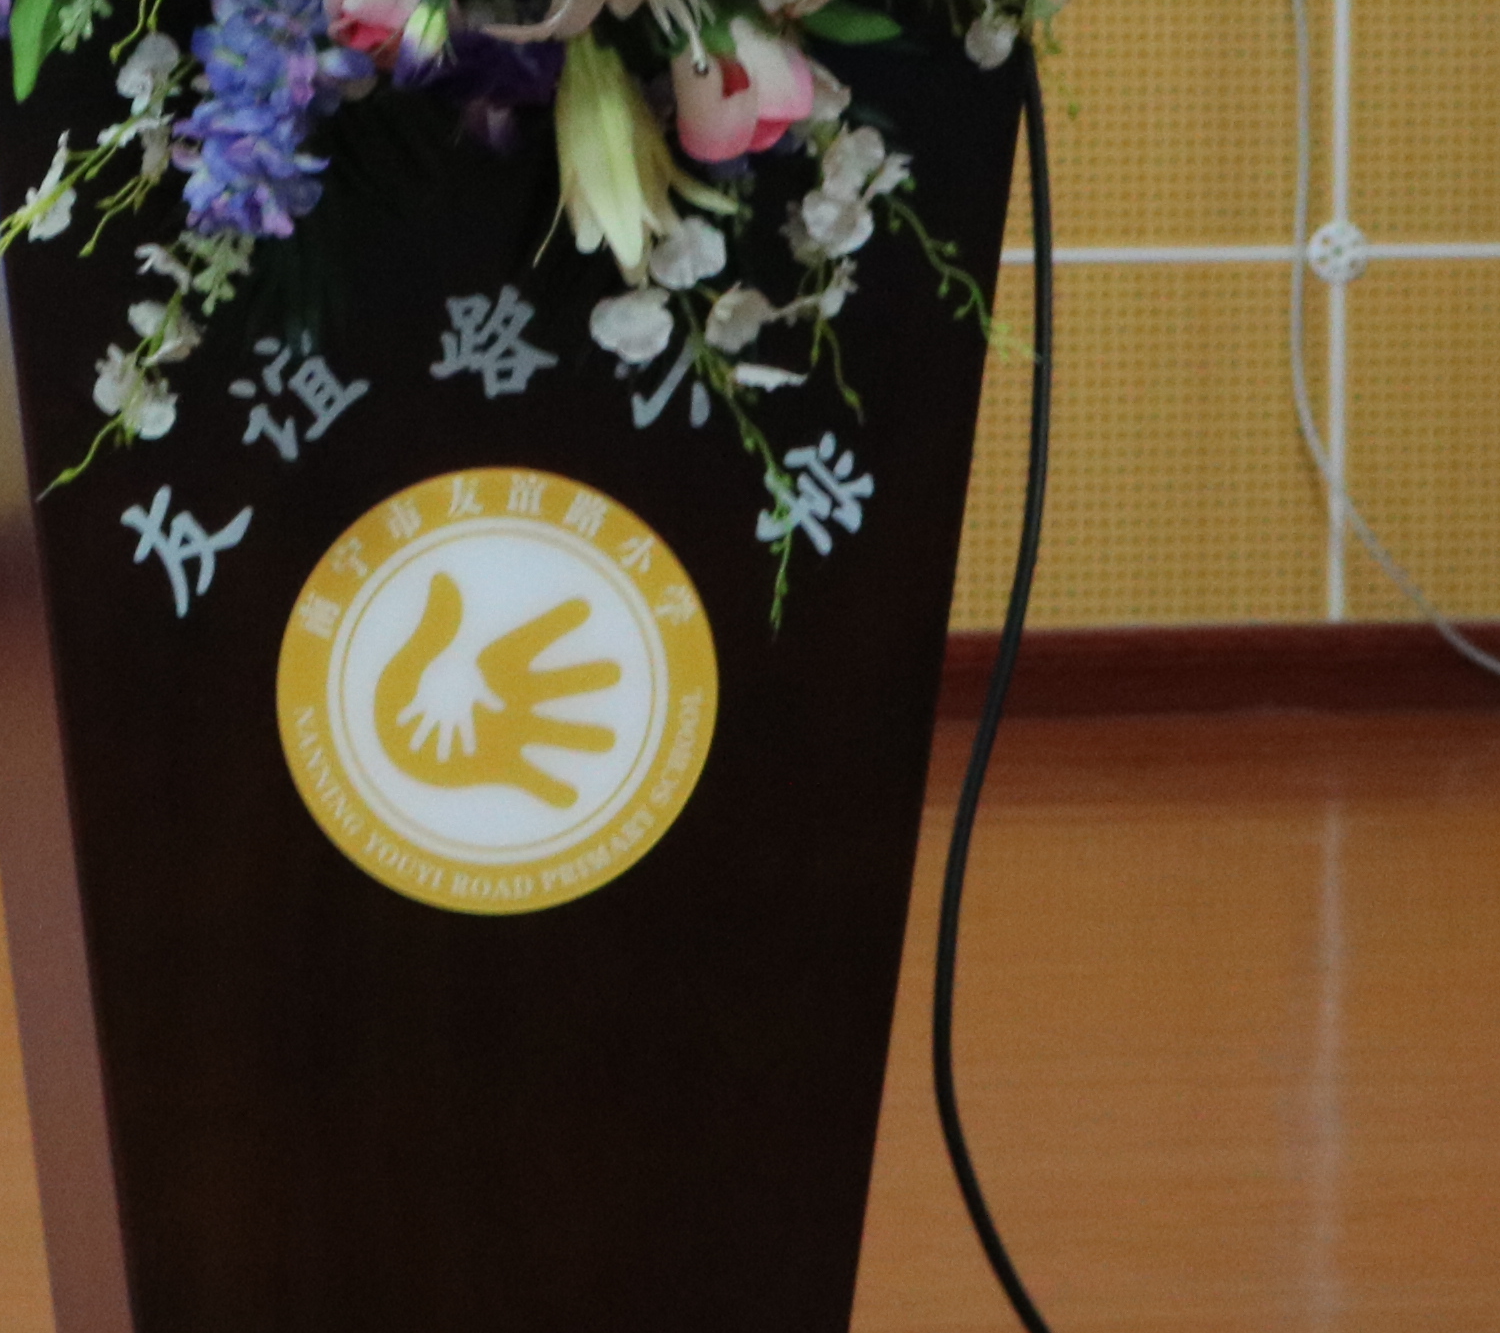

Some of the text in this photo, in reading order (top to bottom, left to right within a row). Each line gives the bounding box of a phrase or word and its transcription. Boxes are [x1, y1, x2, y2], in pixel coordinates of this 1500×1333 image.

[120, 284, 876, 619] 友谊路小学
[298, 472, 701, 640] 南宁市友谊路小学
[293, 687, 704, 900] NANNING YOUYI ROAD PRIMARY SCHOOL
